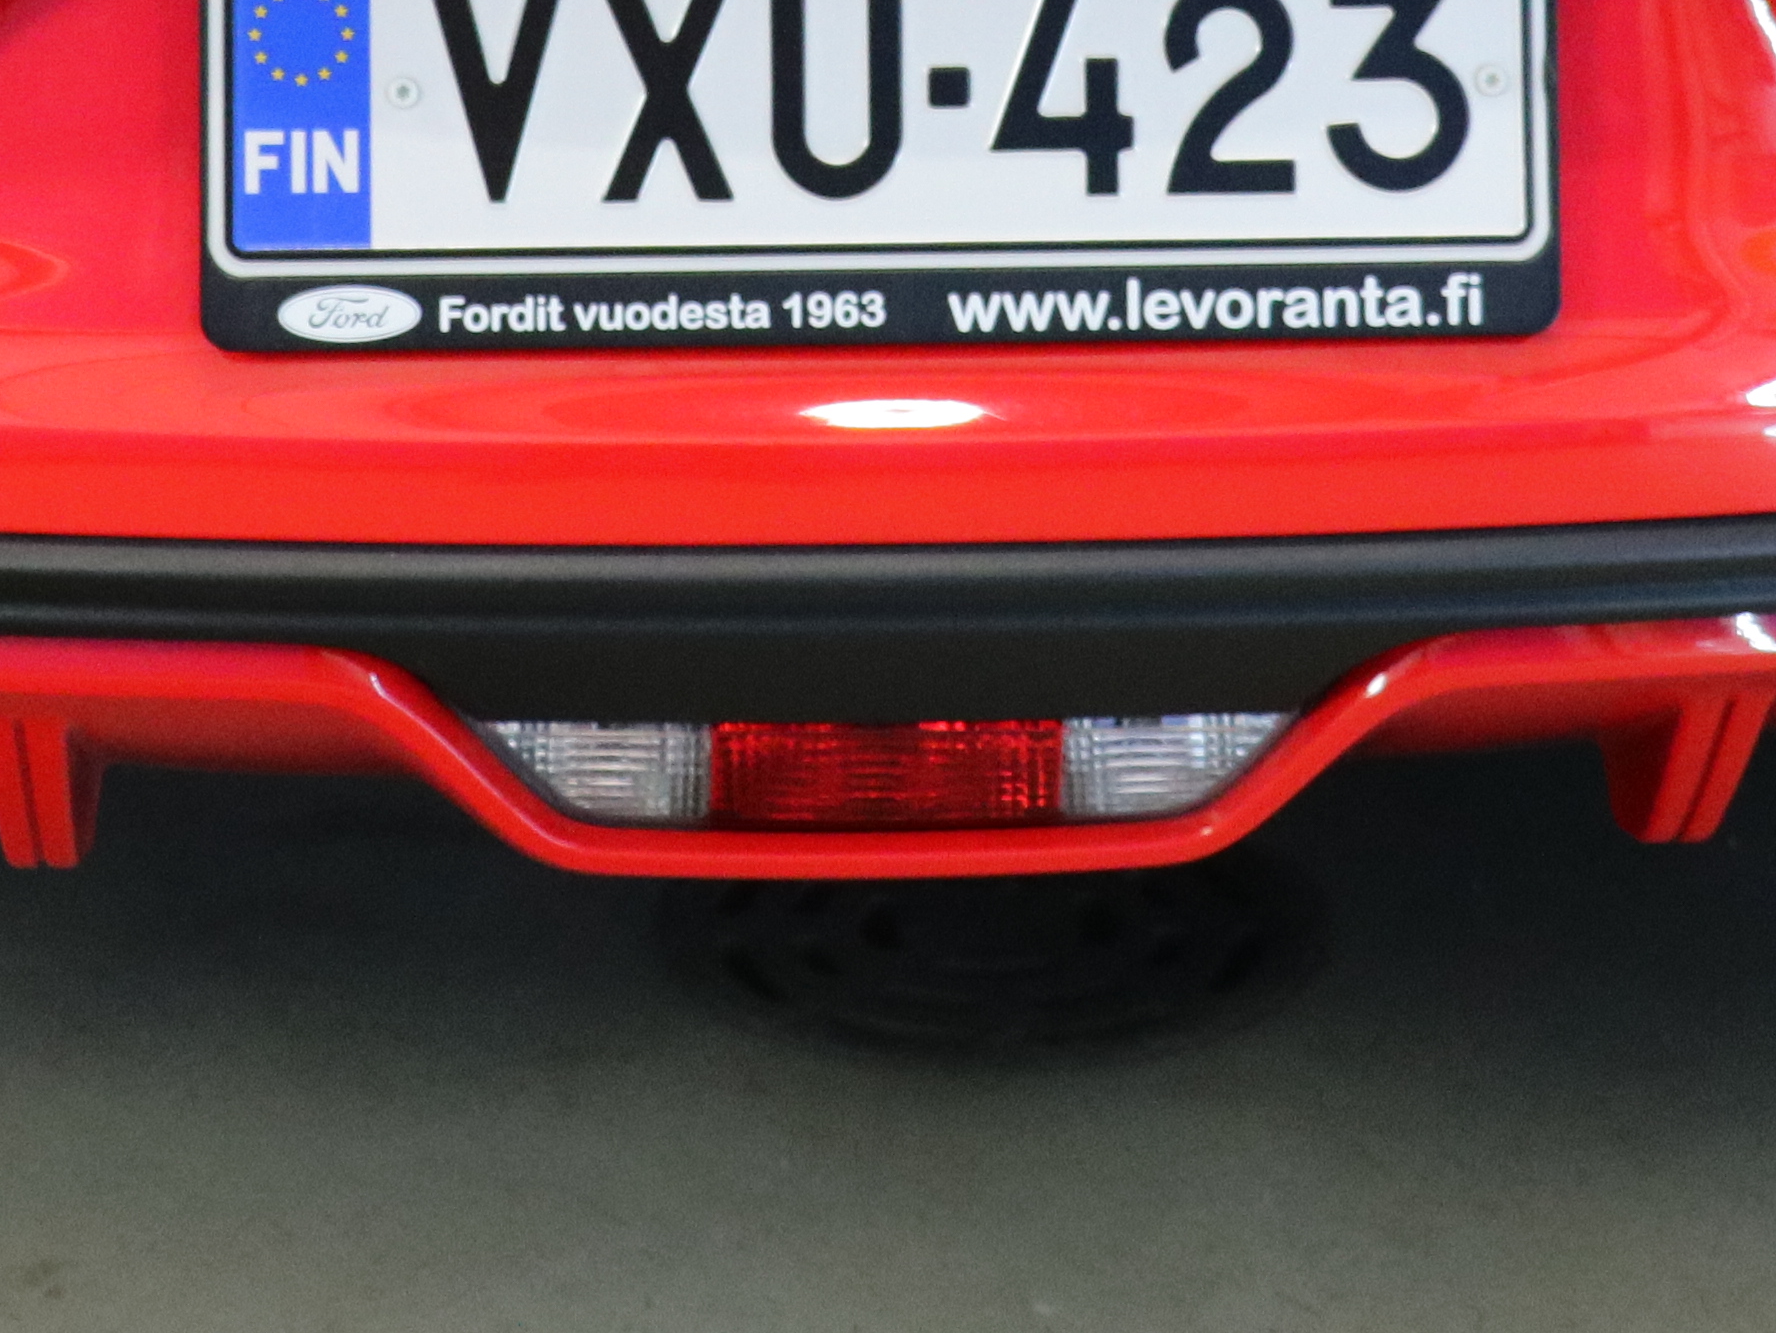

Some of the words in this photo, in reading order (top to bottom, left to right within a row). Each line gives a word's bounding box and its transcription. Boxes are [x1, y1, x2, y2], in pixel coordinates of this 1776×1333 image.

[243, 130, 362, 196] FIN
[307, 296, 389, 331] Ford
[438, 296, 566, 334] Fordit
[573, 294, 772, 332] vuodesta
[782, 292, 888, 329] 1963
[947, 273, 1486, 333] www.levoranta.fi
